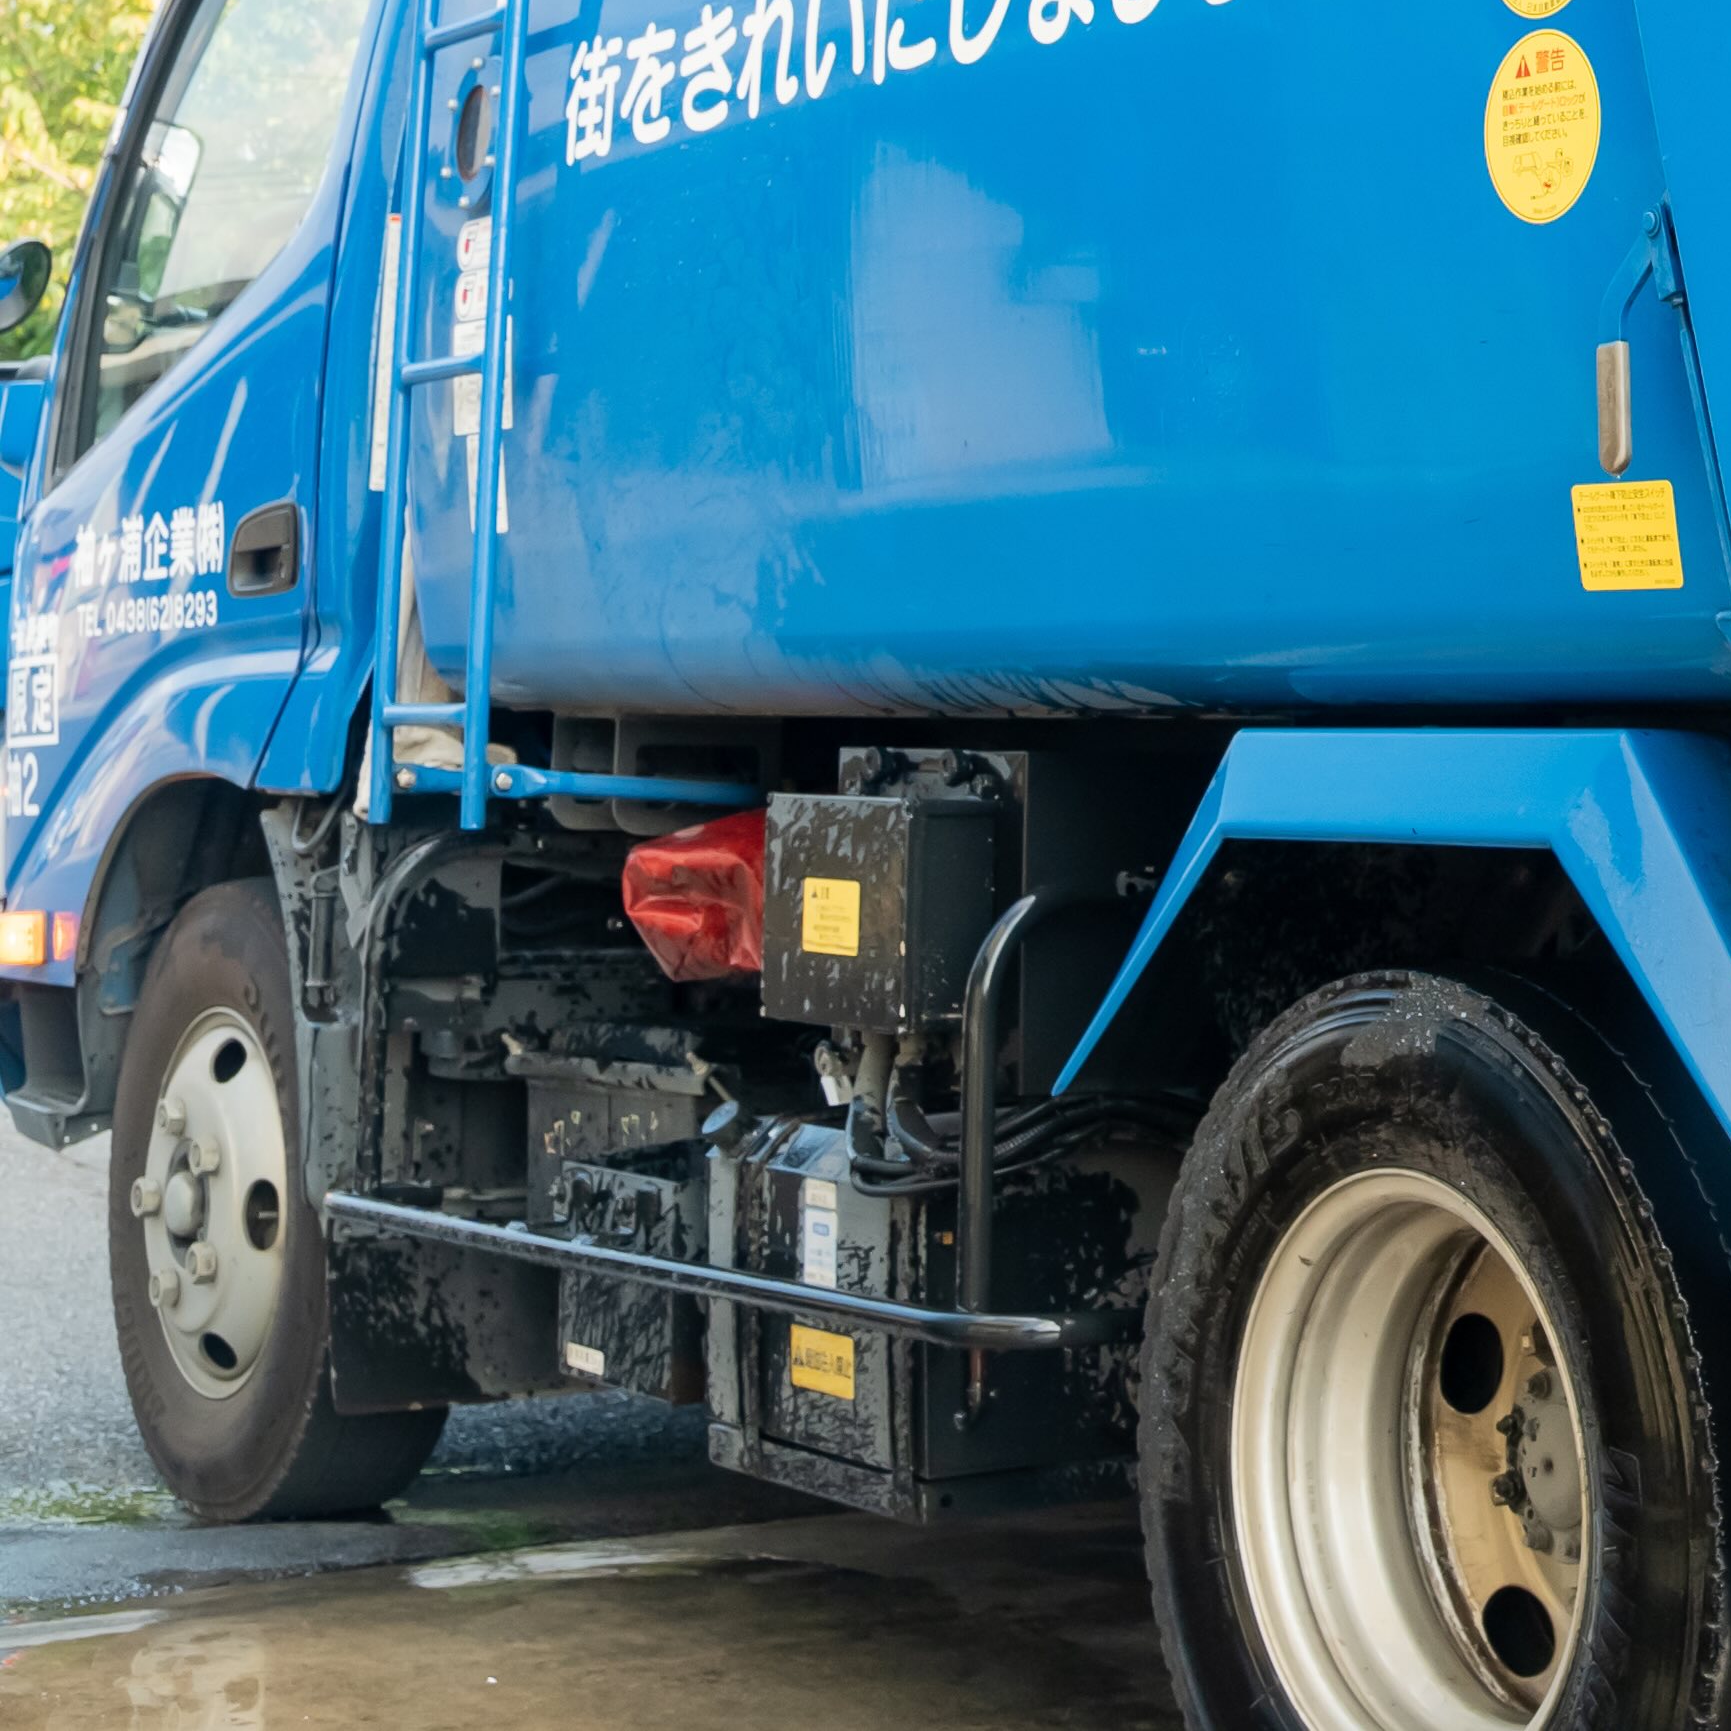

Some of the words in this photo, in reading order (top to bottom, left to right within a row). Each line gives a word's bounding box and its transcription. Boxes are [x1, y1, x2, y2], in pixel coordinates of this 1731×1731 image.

[1535, 48, 1565, 74] 警告
[77, 603, 102, 637] TEL
[106, 590, 219, 635] 0438(62)8293
